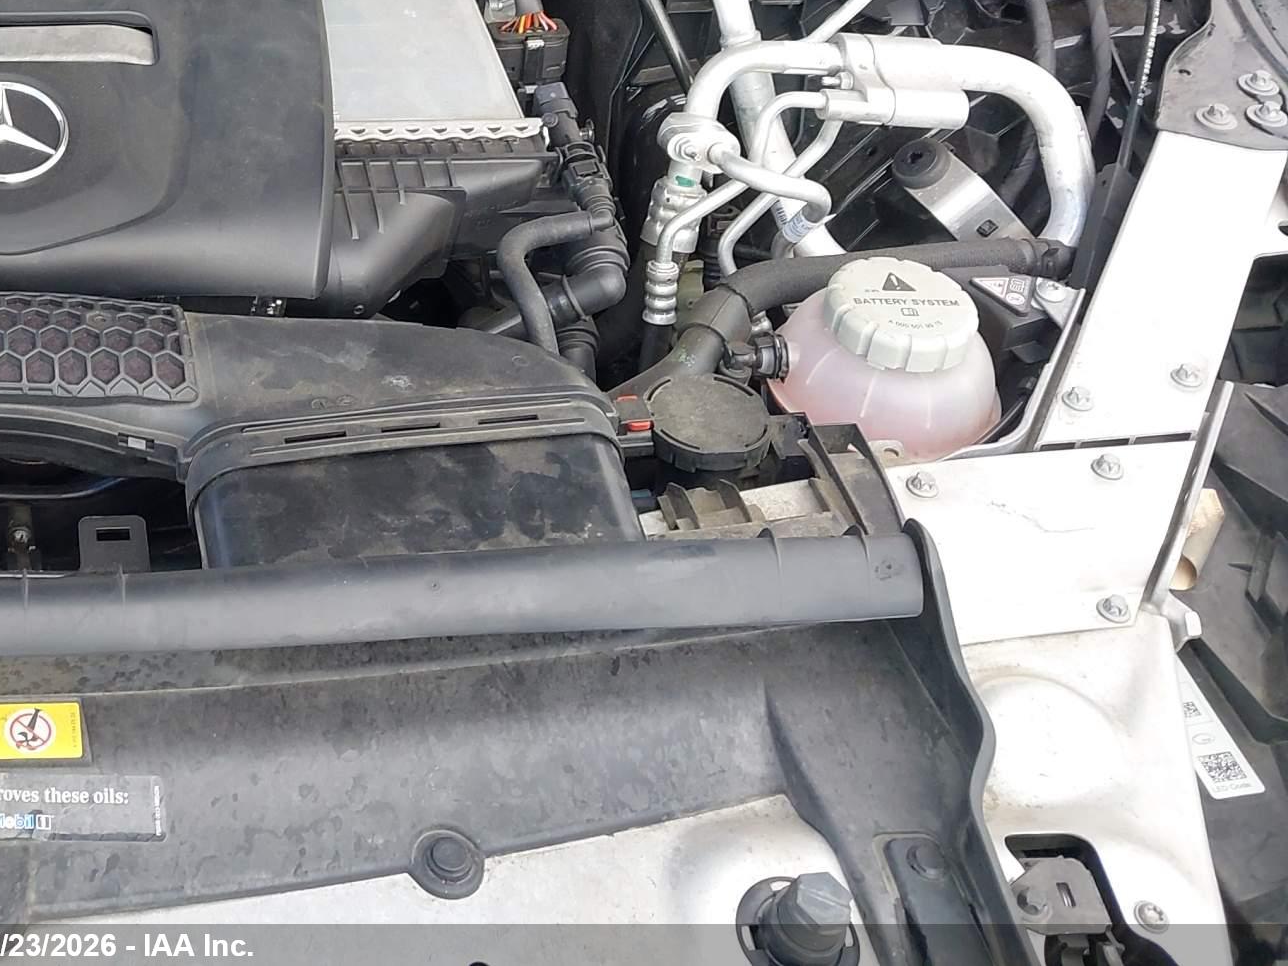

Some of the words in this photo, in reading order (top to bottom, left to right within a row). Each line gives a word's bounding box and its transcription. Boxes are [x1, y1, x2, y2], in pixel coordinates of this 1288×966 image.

[853, 297, 907, 305] BATTERY
[911, 299, 960, 307] SYSTEM
[44, 787, 90, 803] these
[93, 787, 129, 804] oils:
